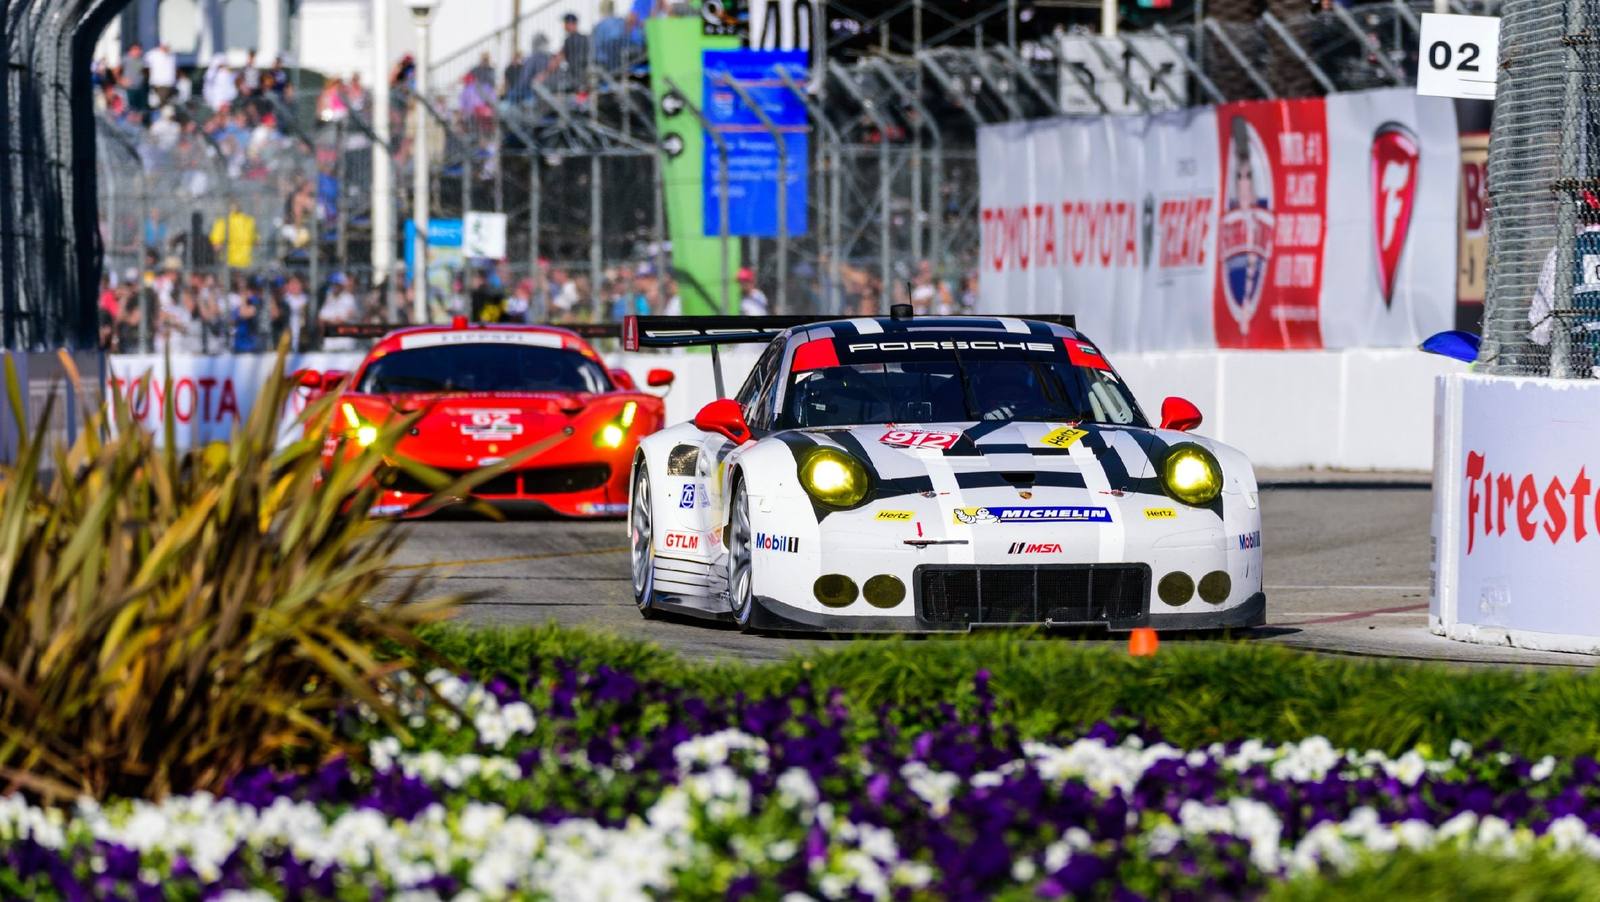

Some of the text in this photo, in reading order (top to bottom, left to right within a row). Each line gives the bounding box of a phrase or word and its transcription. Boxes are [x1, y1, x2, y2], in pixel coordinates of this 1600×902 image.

[1428, 40, 1480, 72] 02
[982, 202, 1057, 272] TOYOTA
[1062, 199, 1138, 267] TOYOTA
[1158, 194, 1214, 268] TECATE
[848, 341, 1055, 352] PORSCHE
[107, 376, 241, 423] TOYOTA
[471, 413, 511, 427] 62
[884, 431, 952, 449] 912
[1047, 429, 1079, 447] Hertz
[1465, 449, 1600, 556] Firest
[878, 511, 910, 520] Hertz
[1001, 509, 1107, 518] MICHELIN
[1146, 509, 1173, 518] Hertz
[665, 533, 699, 549] GTLM
[756, 532, 787, 552] Mobil
[1025, 543, 1063, 554] IMSA
